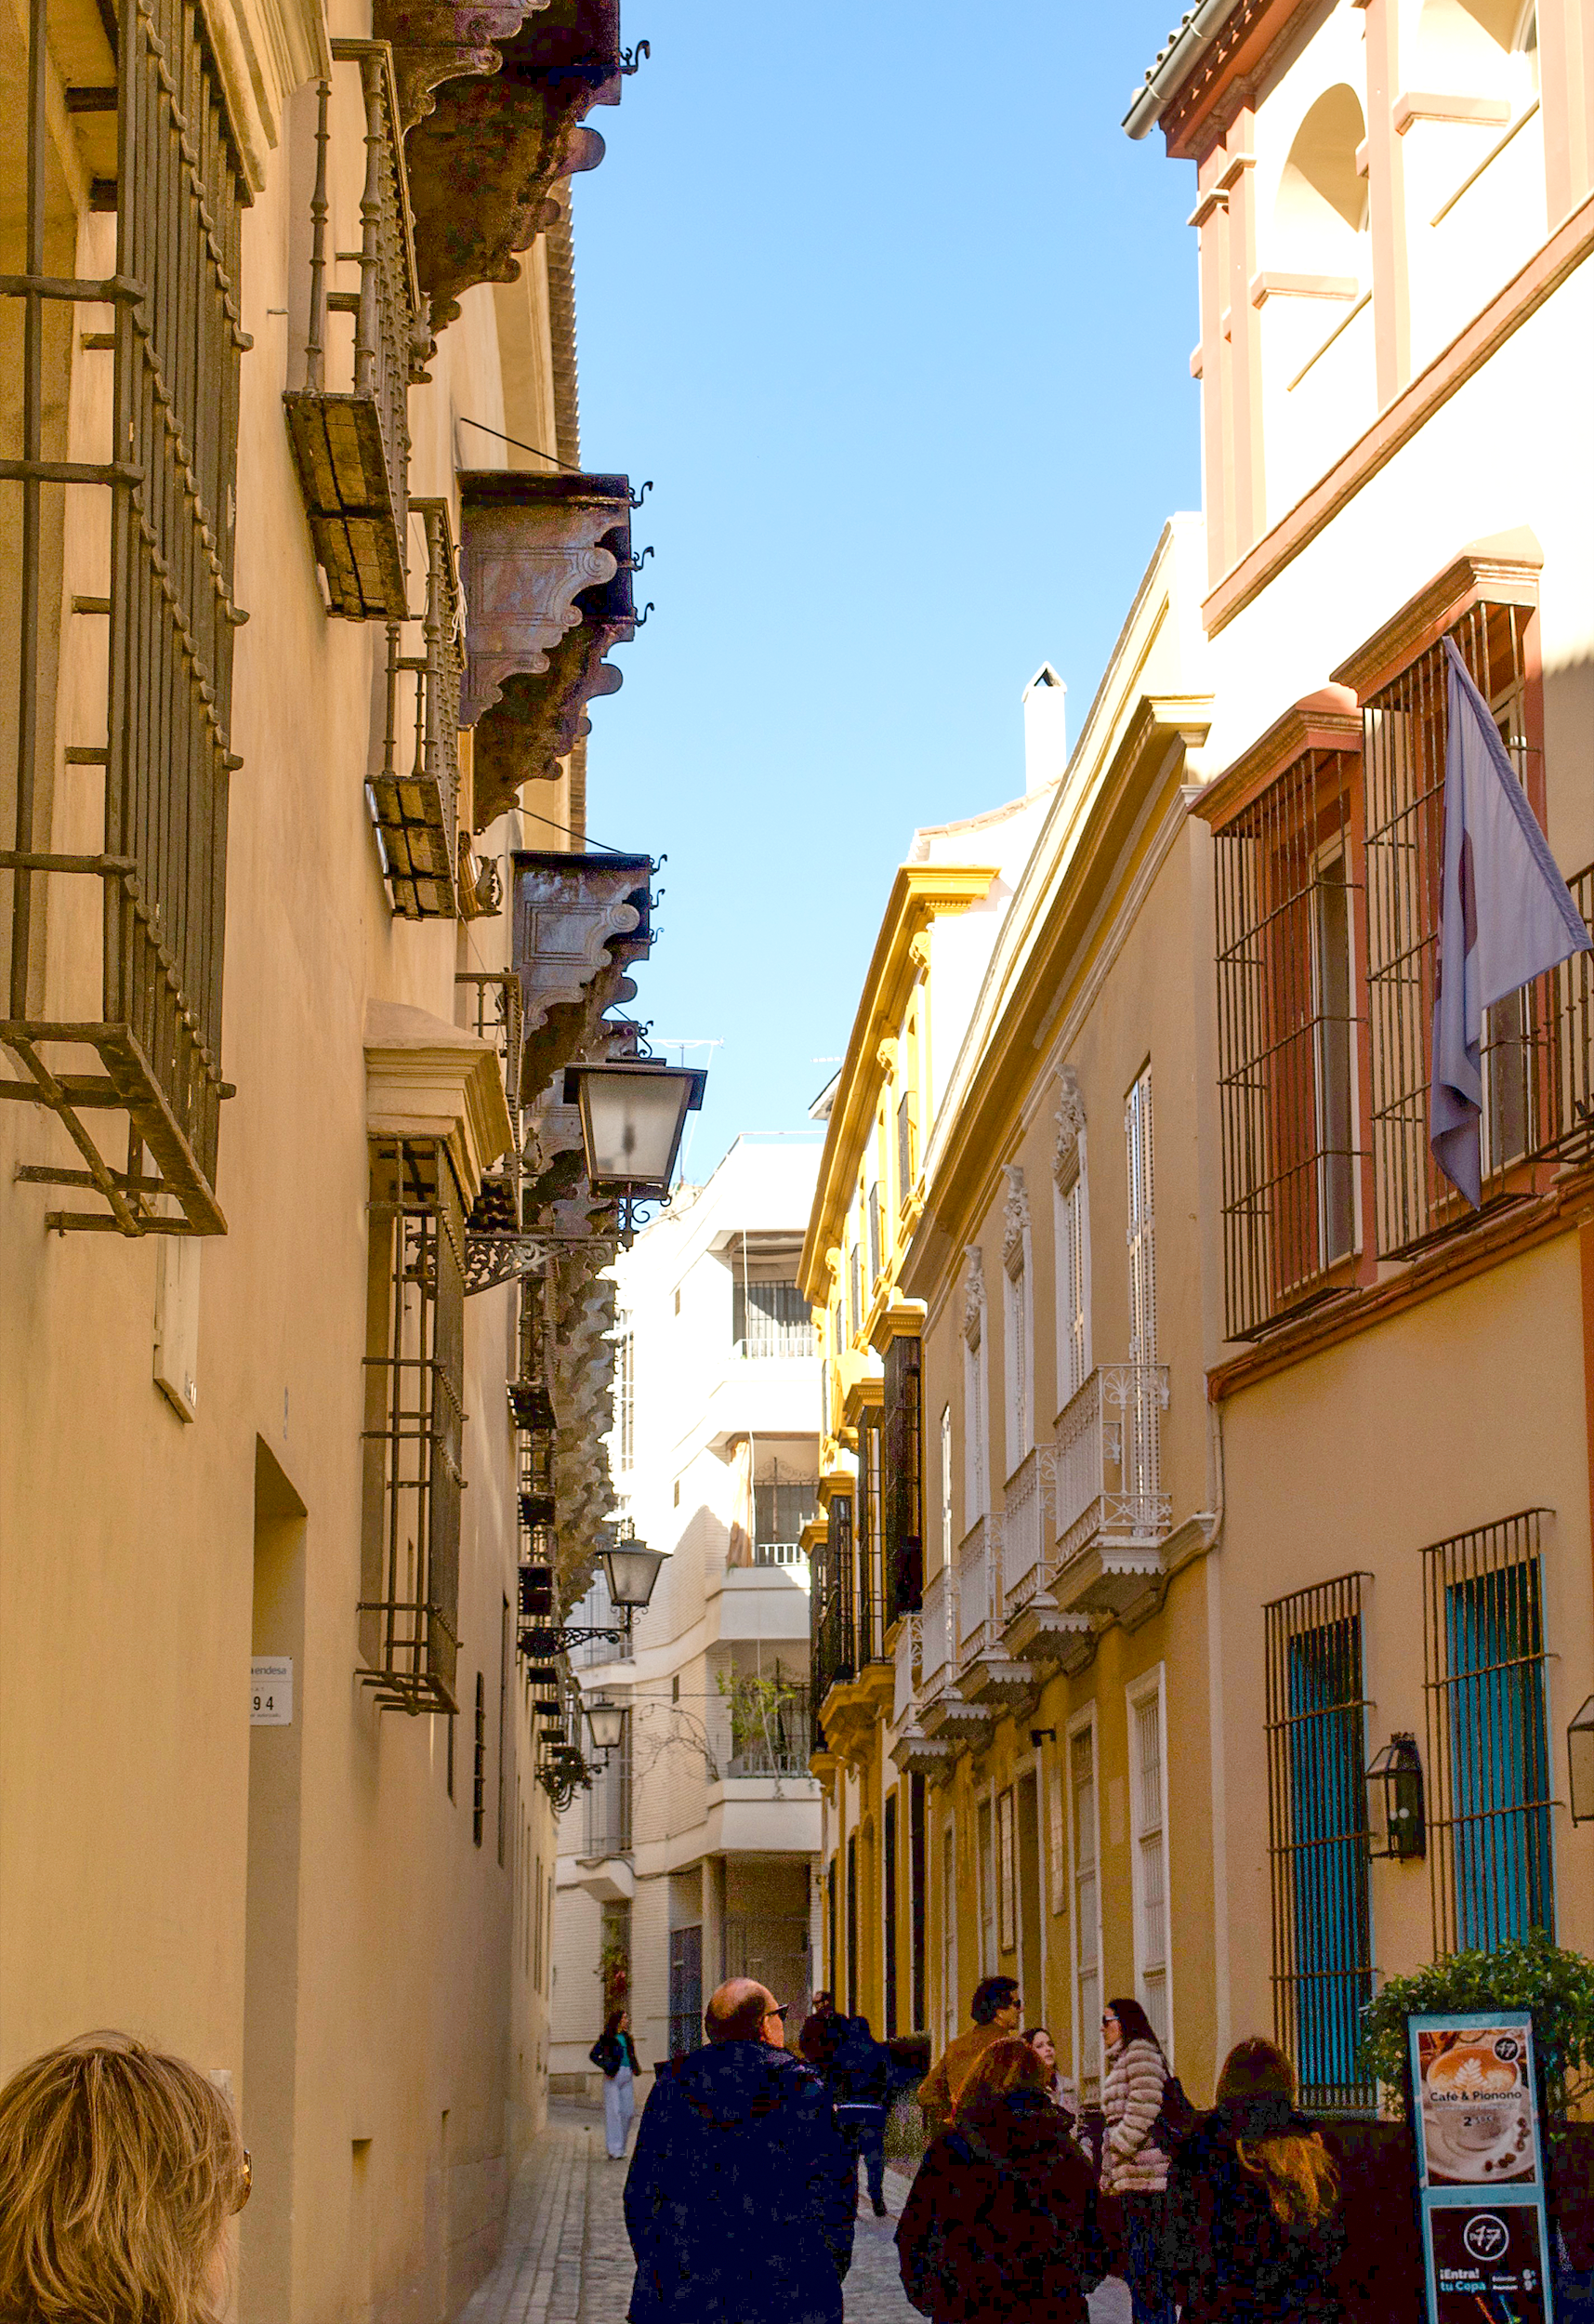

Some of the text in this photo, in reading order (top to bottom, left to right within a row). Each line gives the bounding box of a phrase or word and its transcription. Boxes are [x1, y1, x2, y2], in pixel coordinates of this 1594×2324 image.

[255, 1666, 286, 1674] endesa
[1461, 2091, 1469, 2100] &
[1472, 2091, 1522, 2100] Pionono
